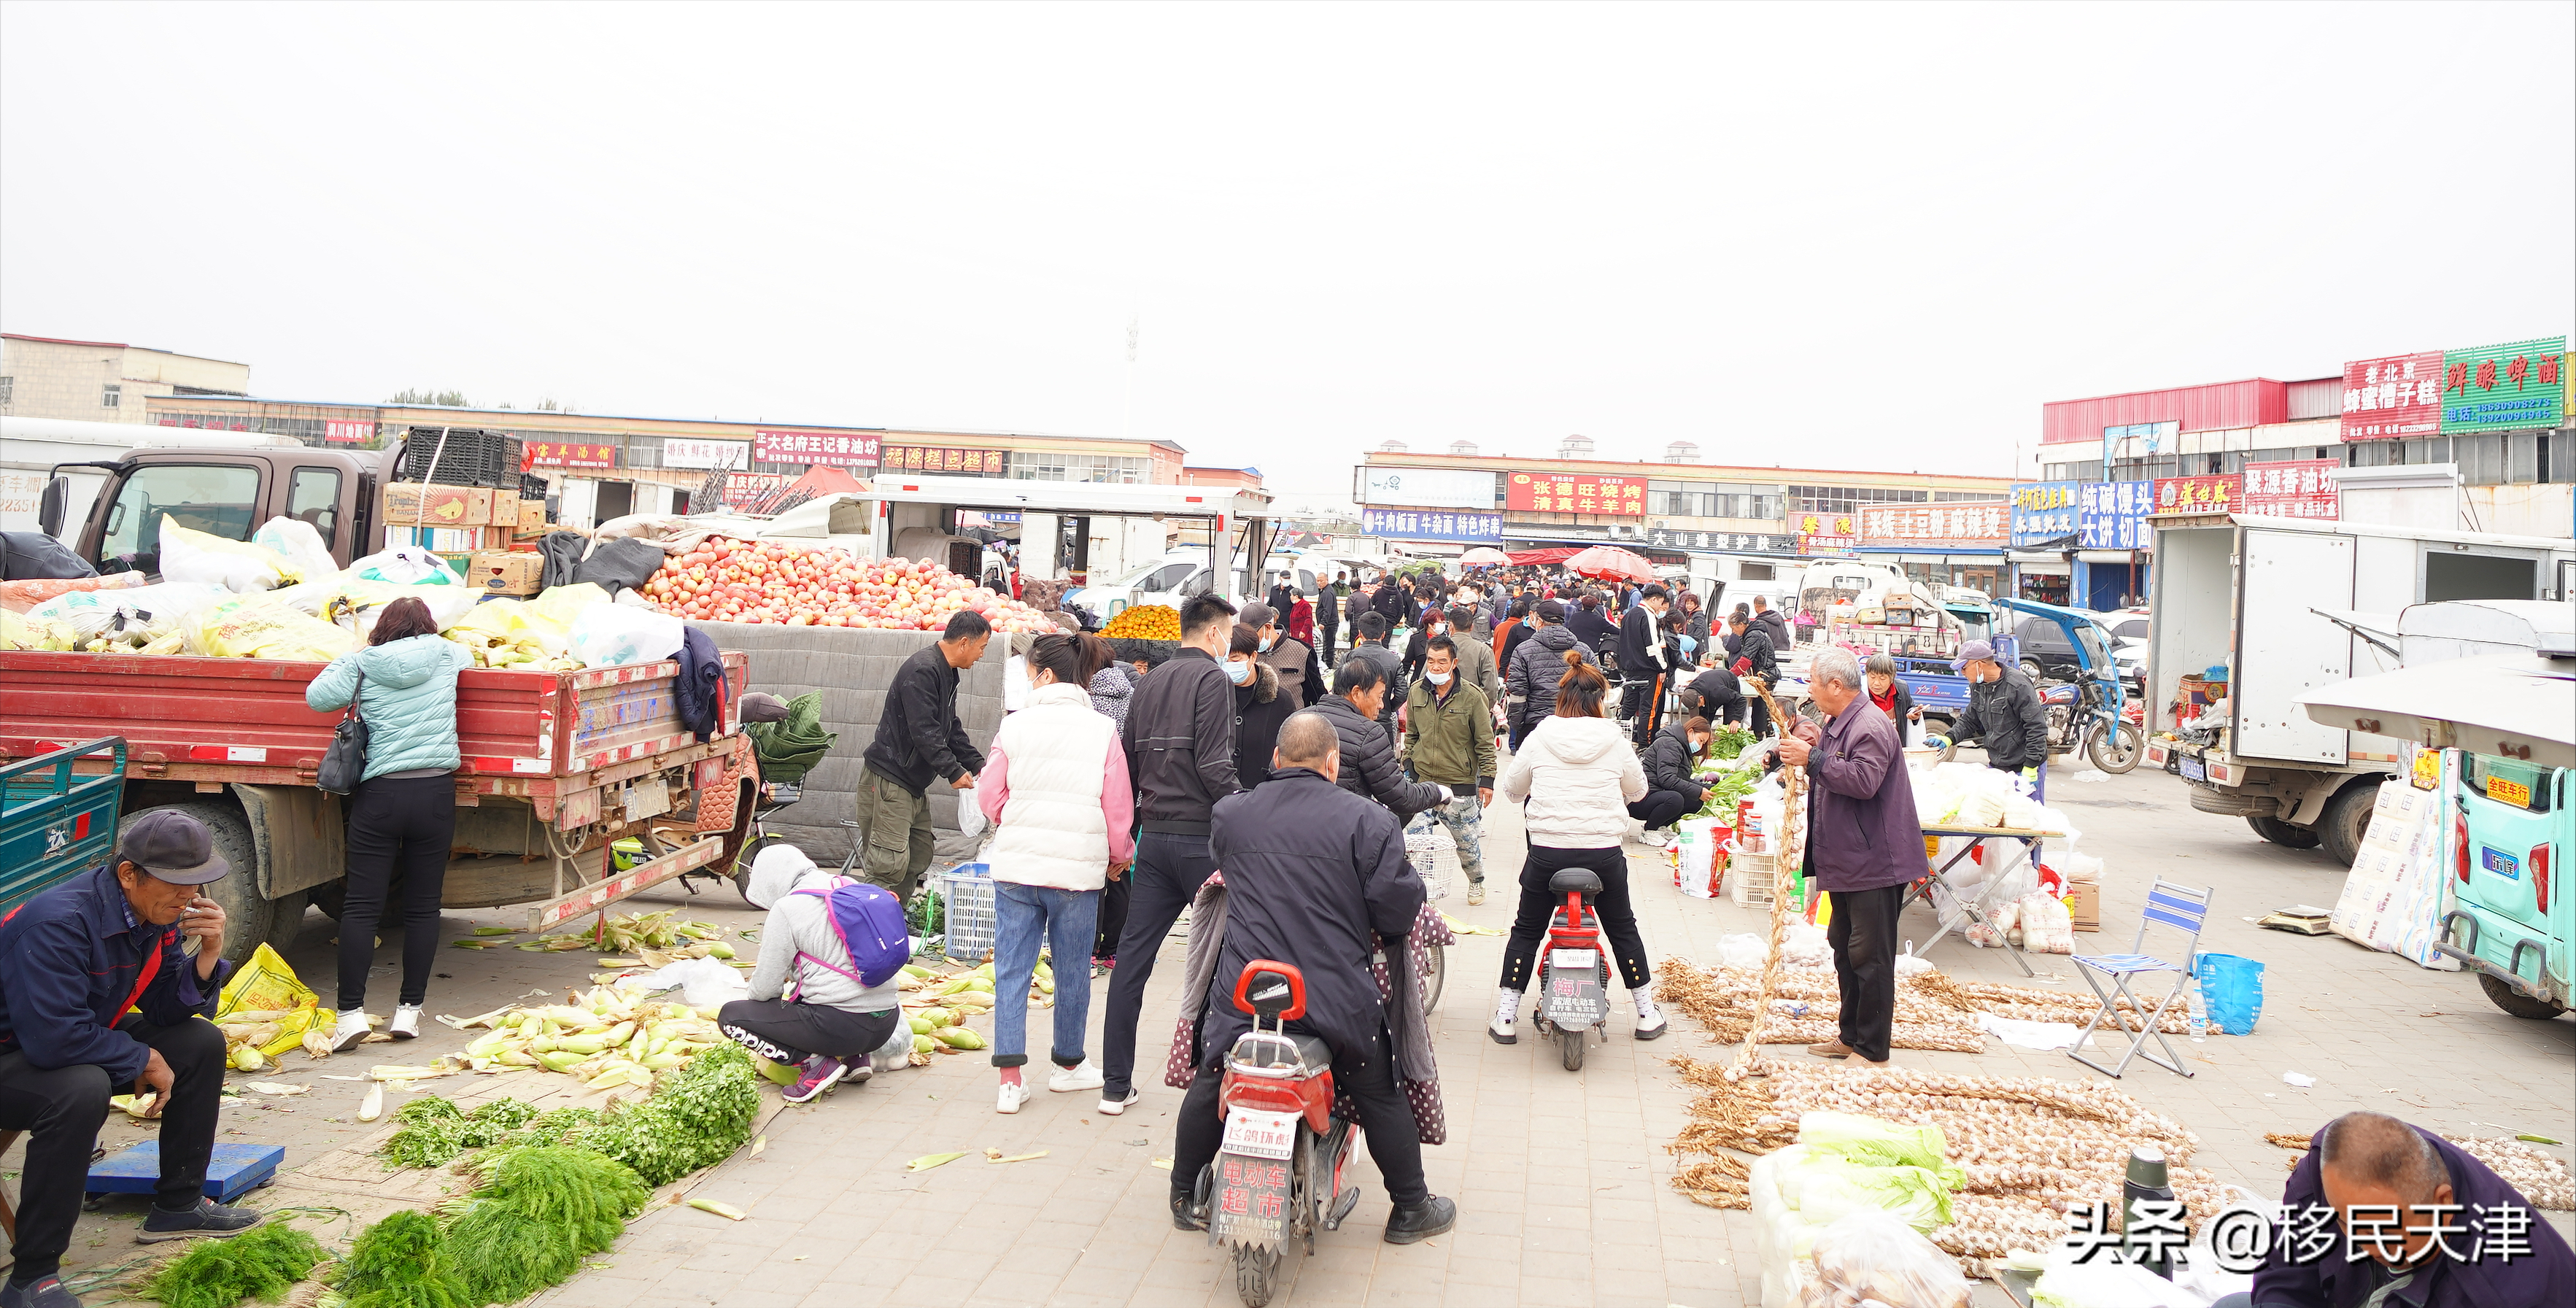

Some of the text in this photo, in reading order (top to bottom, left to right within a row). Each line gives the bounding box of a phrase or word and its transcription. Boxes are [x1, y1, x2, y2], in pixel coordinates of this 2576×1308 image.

[2364, 361, 2416, 384] 老北京
[2445, 353, 2558, 396] 鲜酿啤酒
[2343, 379, 2438, 414] 蜂蜜槽子糕
[667, 442, 686, 457] 婚庆
[691, 443, 711, 458] 鲜花
[756, 433, 767, 459] 正宗
[767, 434, 878, 455] 大名府王记香油坊
[885, 447, 1002, 469] 福源糕点超市
[1533, 481, 1642, 498] 张德旺烧烤
[2245, 467, 2337, 495] 聚源香油坊
[1533, 496, 1641, 514] 清真牛羊肉
[2081, 483, 2153, 515] 纯碱馒头
[2247, 503, 2286, 517] 批发零售
[2294, 501, 2337, 517] 精品礼盒
[1374, 511, 1500, 537] 牛肉板面 牛杂面 特色炸串
[1868, 509, 1896, 538] 米线
[1900, 508, 1945, 538] 土豆粉
[1949, 506, 2001, 538] 麻辣烫
[2081, 514, 2152, 548] 大饼 切面
[1653, 530, 1770, 551] 大山造型护肤
[2488, 778, 2528, 800] 全旺车行
[2488, 791, 2528, 808] 15002250585
[1552, 977, 1596, 997] 梅厂
[1223, 1158, 1287, 1191] 电动车
[1220, 1187, 1285, 1219] 超市
